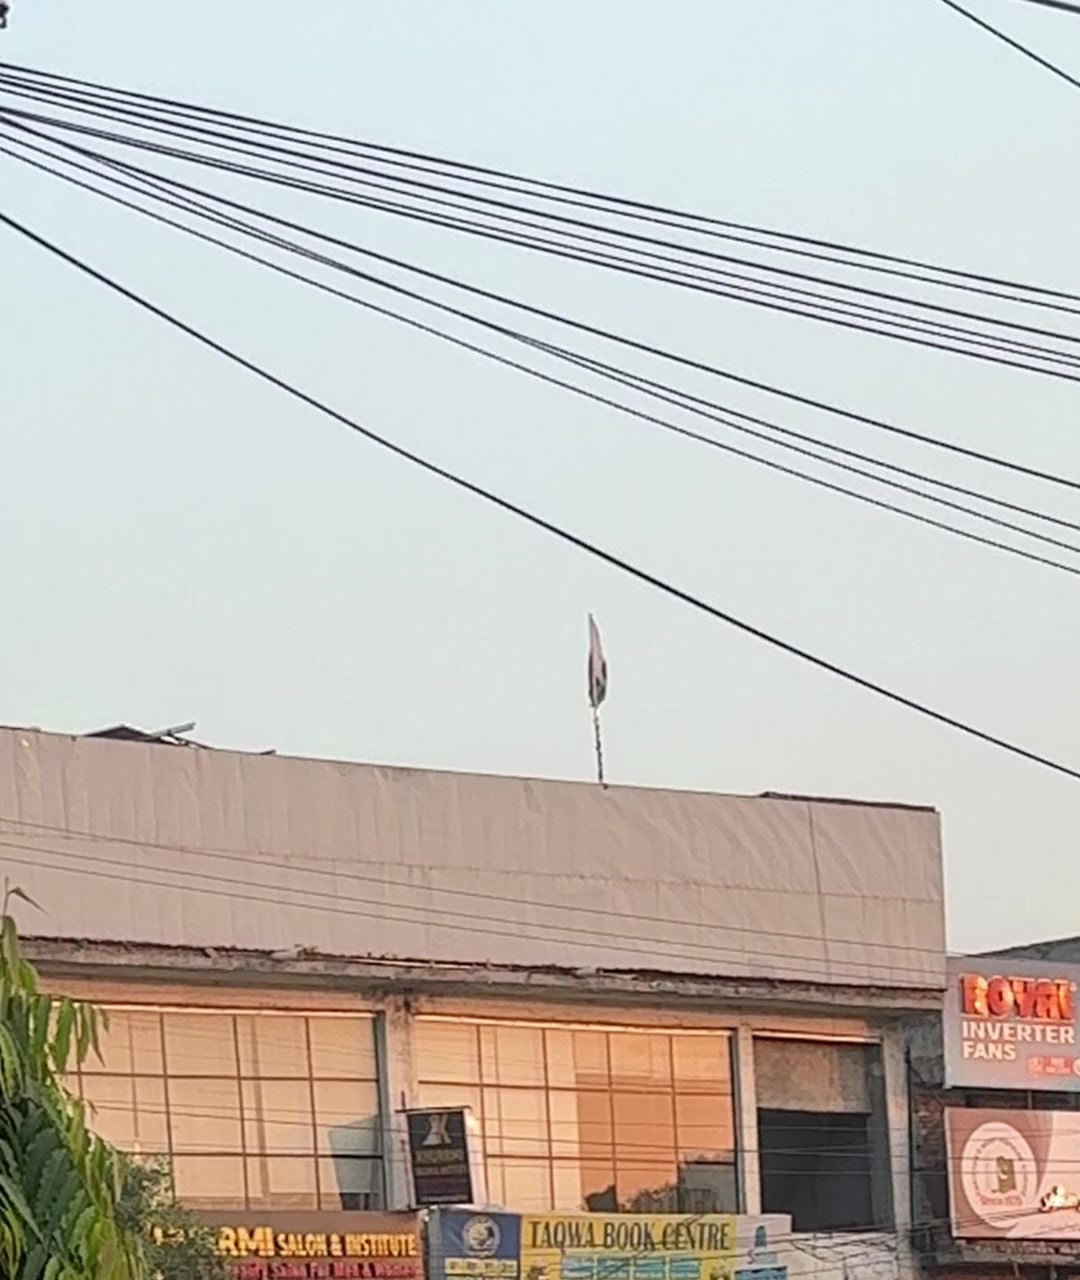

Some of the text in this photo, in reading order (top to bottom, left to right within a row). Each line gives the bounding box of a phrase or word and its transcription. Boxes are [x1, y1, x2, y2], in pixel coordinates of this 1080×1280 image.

[962, 1020, 1076, 1044] INVERTER
[962, 1040, 1017, 1061] FANS
[276, 1233, 327, 1257] SALON
[329, 1234, 343, 1256] &
[345, 1234, 417, 1257] INSTITUTE
[528, 1220, 730, 1250] TAQWA BOOK CENTRE
